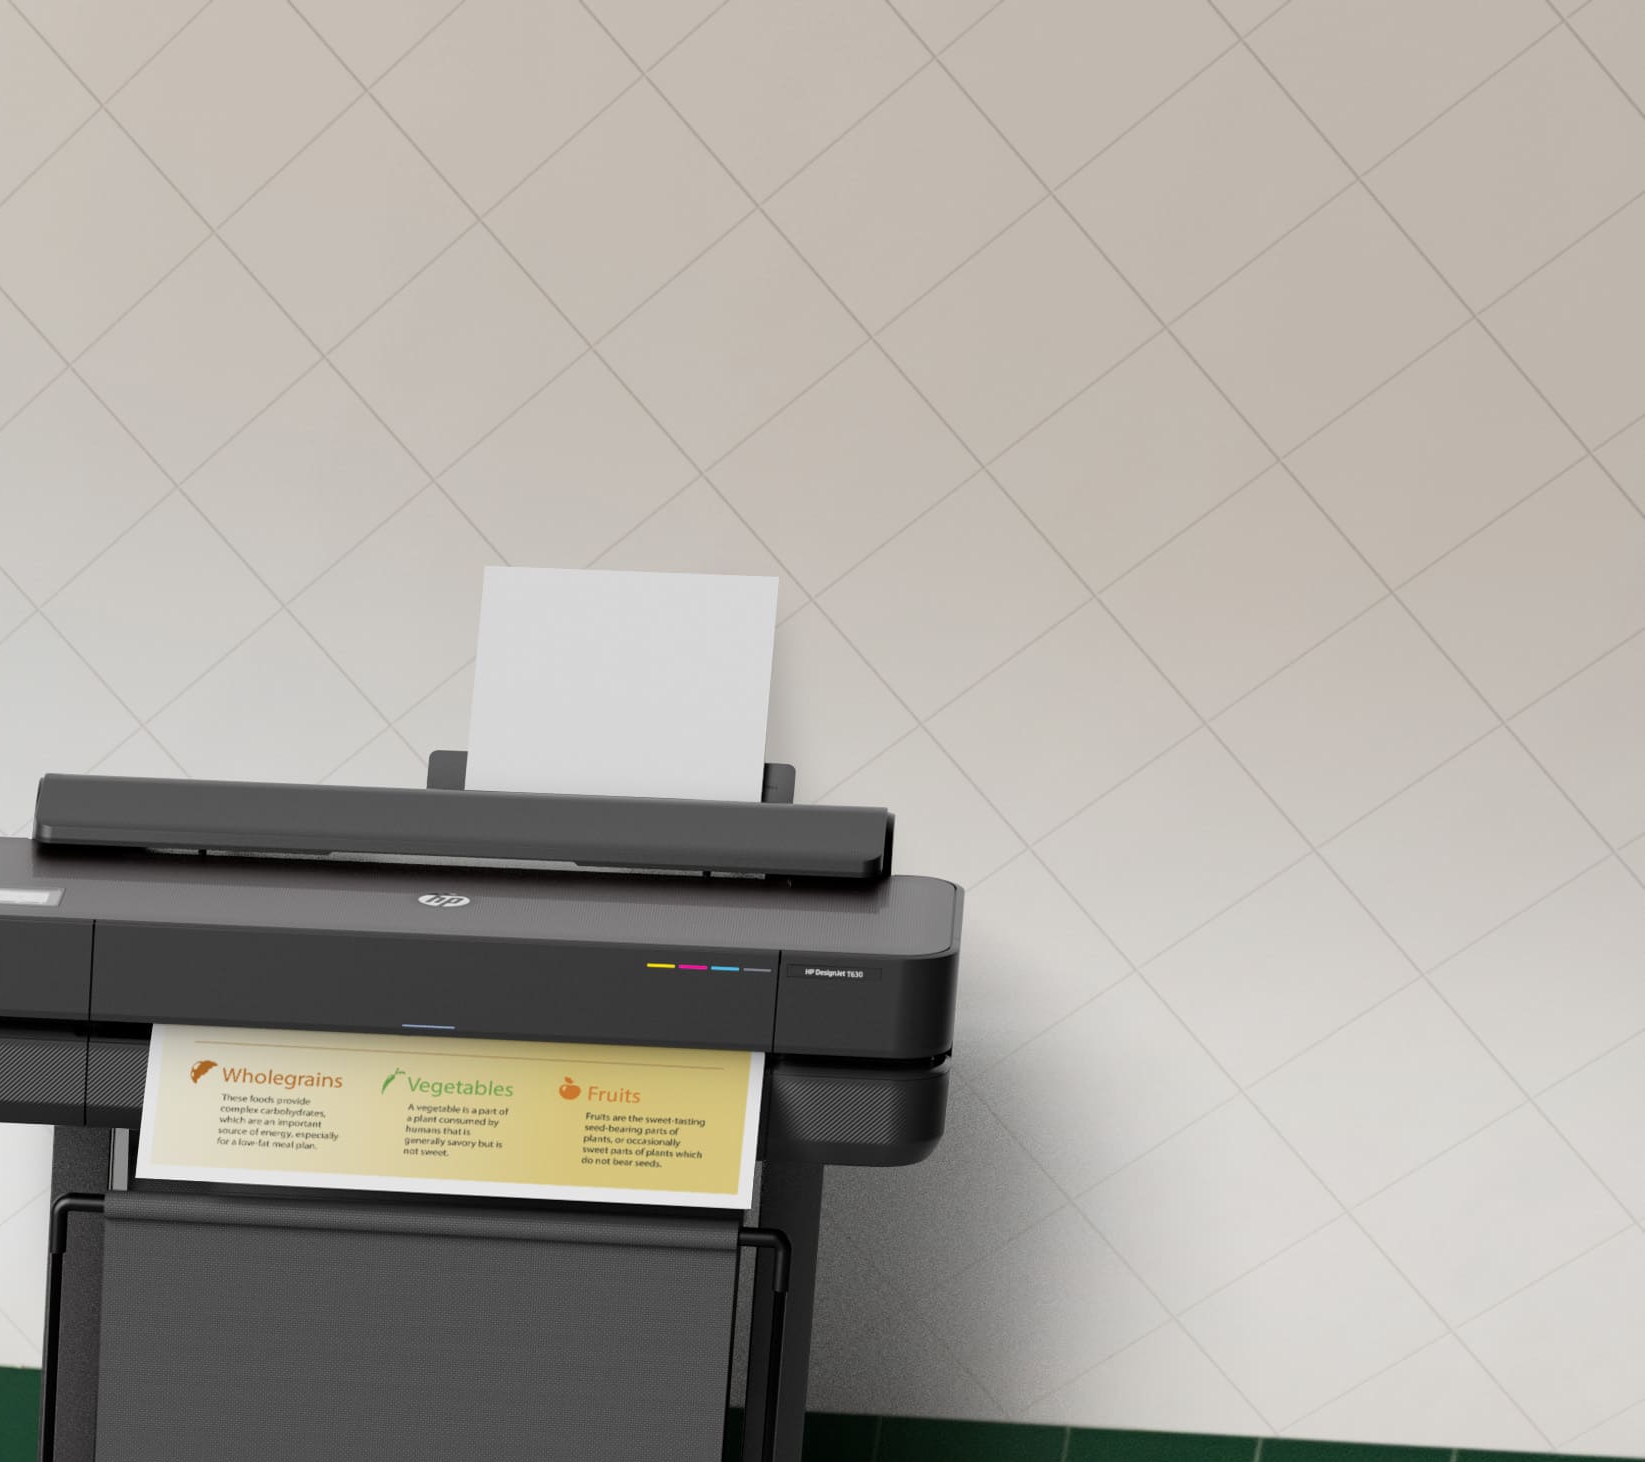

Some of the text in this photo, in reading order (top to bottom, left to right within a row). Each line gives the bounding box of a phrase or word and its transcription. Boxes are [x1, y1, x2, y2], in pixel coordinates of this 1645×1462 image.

[222, 1067, 343, 1089] Wholegrains
[408, 1076, 514, 1097] Vegetables
[221, 1093, 311, 1106] These foods provide
[587, 1086, 641, 1104] Fruits
[220, 1105, 326, 1118] complex carbohydrates,
[408, 1103, 415, 1111] A
[417, 1104, 460, 1114] vegetable
[478, 1108, 497, 1117] part
[499, 1108, 509, 1116] of
[219, 1116, 246, 1125] which
[278, 1118, 322, 1128] important
[414, 1115, 437, 1124] plant
[438, 1117, 486, 1126] consumed
[488, 1119, 499, 1128] by
[586, 1112, 610, 1121] Fruits
[628, 1114, 643, 1123] the
[646, 1115, 706, 1127] sweet-tasting
[218, 1128, 338, 1141] source of energy, especially
[405, 1126, 470, 1136] humans that is
[585, 1124, 643, 1135] seed-bearing
[645, 1127, 667, 1136] parts
[217, 1137, 230, 1146] for
[238, 1138, 269, 1148] low-fat
[272, 1141, 294, 1149] meal
[404, 1136, 445, 1146] generally
[447, 1139, 476, 1148] savory
[478, 1139, 494, 1148] but
[583, 1135, 613, 1144] plants,
[626, 1137, 681, 1148] occasionally
[421, 1149, 449, 1157] sweet.
[611, 1148, 633, 1157] parts
[635, 1148, 645, 1156] of
[646, 1149, 673, 1158] plants
[675, 1150, 702, 1159] which
[581, 1156, 593, 1165] do
[613, 1158, 632, 1167] bear
[635, 1159, 662, 1168] seeds.
